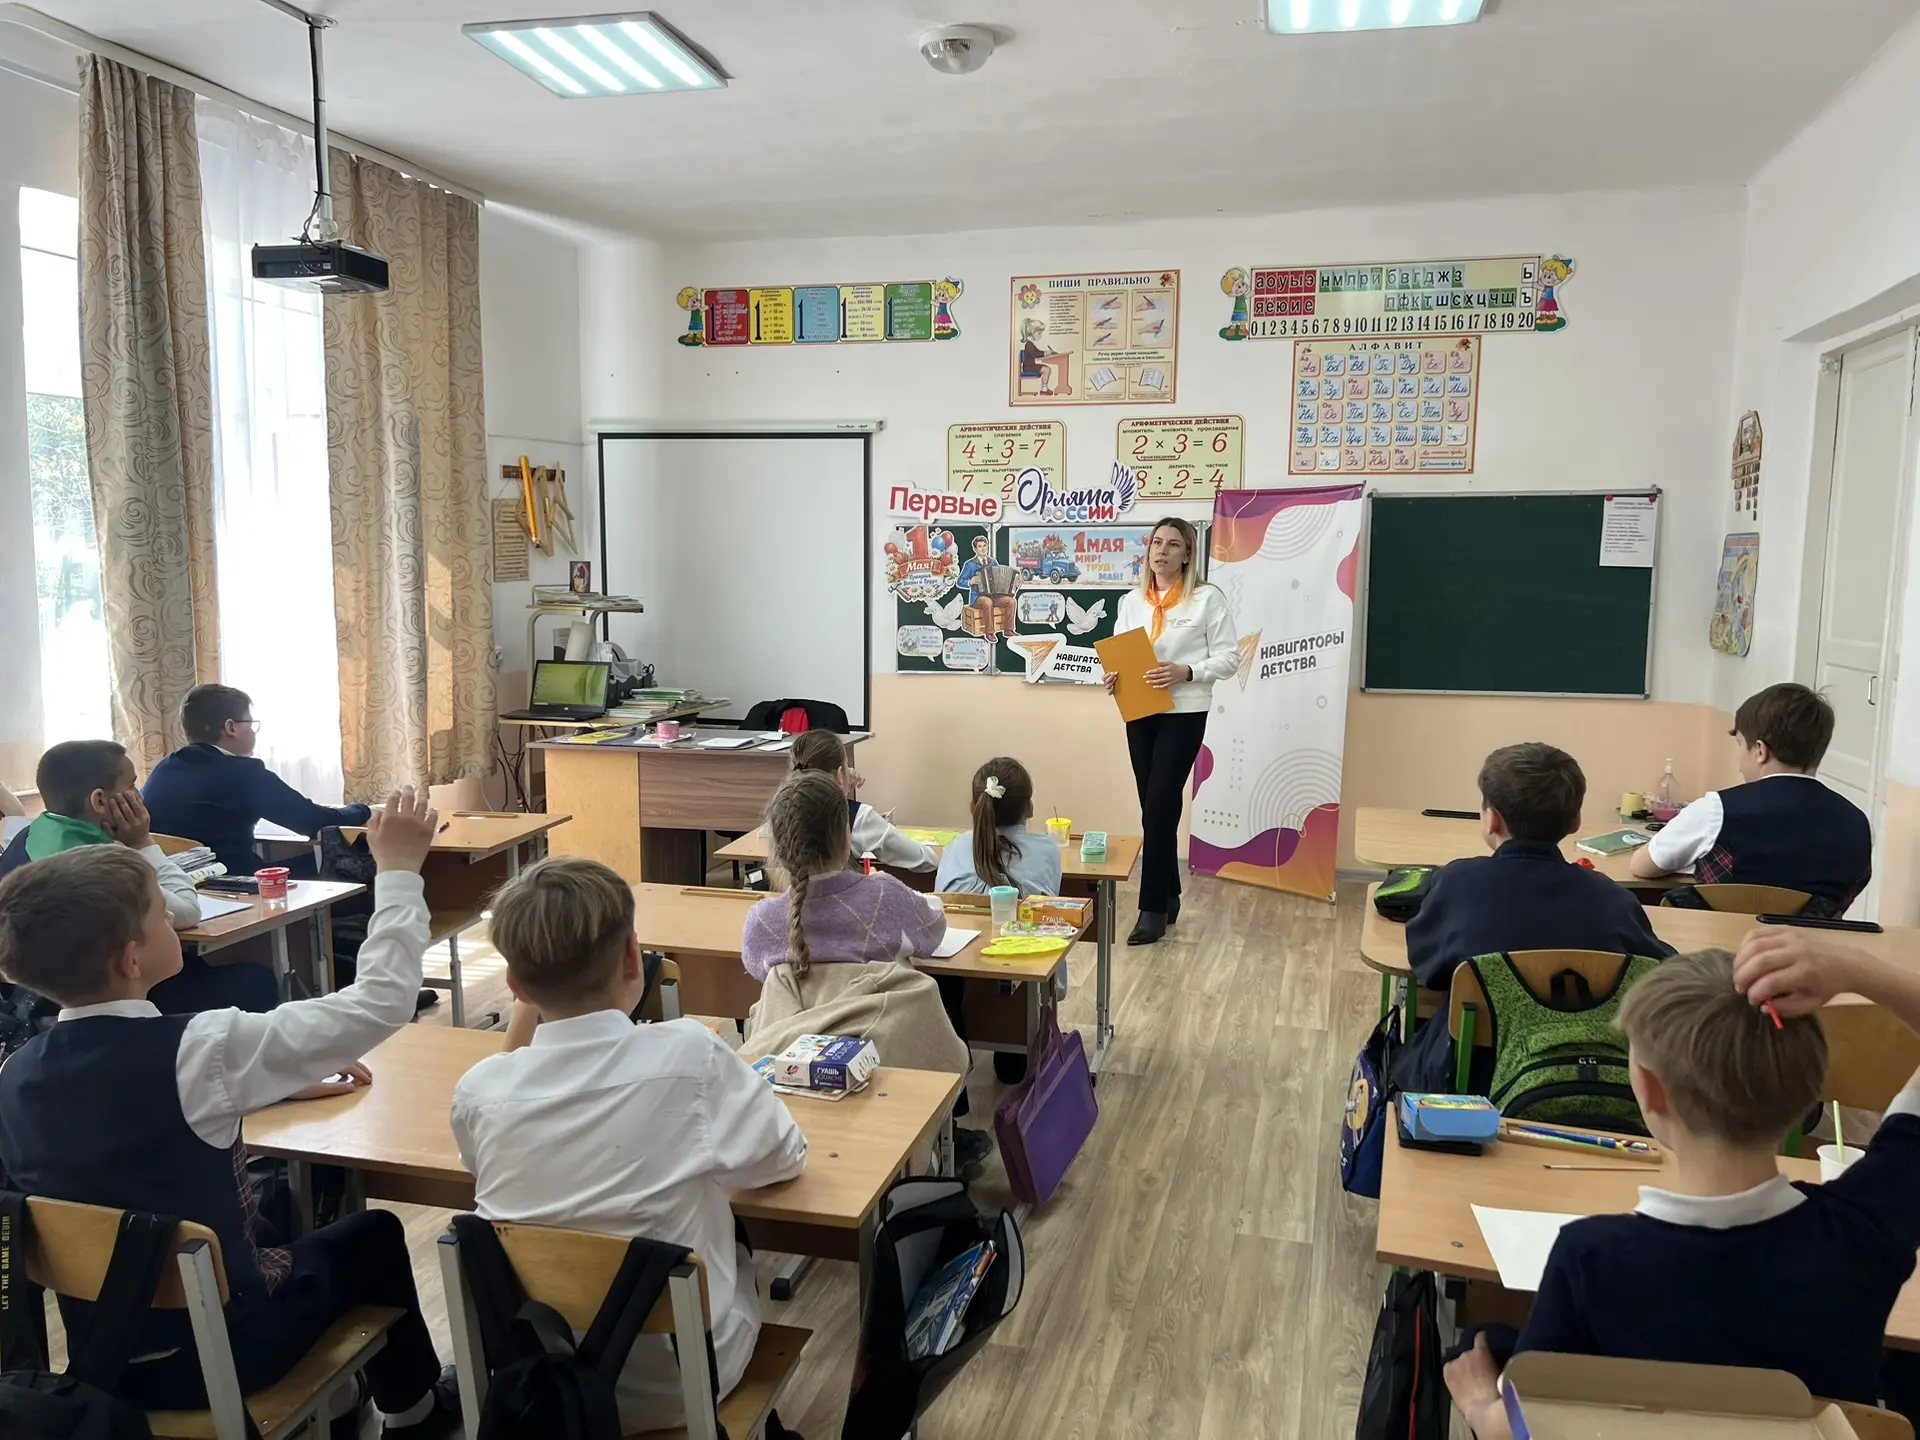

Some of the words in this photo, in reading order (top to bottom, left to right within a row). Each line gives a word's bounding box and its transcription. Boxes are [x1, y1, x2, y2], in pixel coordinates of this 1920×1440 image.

[1048, 280, 1081, 289] ПИШИ
[1087, 276, 1151, 287] ПРАВИЛЬНО
[1251, 321, 1258, 336] 0
[1262, 321, 1266, 336] 1
[1270, 320, 1277, 335] 2
[1280, 320, 1287, 335] 3
[1291, 320, 1298, 335] 4
[1302, 319, 1308, 334] 5
[1312, 319, 1319, 334] 6
[1323, 319, 1329, 334] 7
[1333, 318, 1340, 333] 8
[1344, 318, 1351, 333] 9
[1355, 317, 1367, 332] 10
[1371, 317, 1381, 332] 11
[1385, 316, 1397, 332] 12
[1401, 316, 1414, 331] 13
[1418, 315, 1430, 331] 14
[1434, 315, 1447, 330] 15
[1451, 314, 1464, 330] 16
[1468, 314, 1480, 329] 17
[1484, 313, 1497, 329] 18
[1501, 312, 1514, 328] 19
[1518, 312, 1534, 328] 20
[1348, 341, 1424, 351] АЛФАВИТ
[1131, 419, 1193, 427] АРИФМЕТИЧЕСКИЕ
[962, 440, 976, 459] 4
[1000, 439, 1015, 459] 3
[1033, 439, 1046, 458] 7
[1132, 434, 1149, 455] 2
[1173, 433, 1188, 454] 3
[1212, 432, 1228, 453] 6
[962, 474, 974, 492] 7
[1000, 473, 1016, 492] 2
[1136, 469, 1148, 490] 8
[1173, 469, 1190, 489] 2
[1209, 468, 1224, 489] 4
[1018, 468, 1116, 516] Орлята
[889, 486, 998, 520] Первые
[906, 524, 929, 559] 1
[1072, 531, 1087, 553] 1
[1087, 537, 1125, 553] МАЯ
[906, 561, 934, 573] Мая!
[1075, 554, 1102, 563] МИР!
[1086, 563, 1115, 572] ТРУД!
[1098, 572, 1124, 581] МАЙ!
[1260, 631, 1345, 660] НАВИГАТОРЫ
[1055, 652, 1102, 665] НАВИГАТО
[1260, 655, 1317, 679] ДЕТСТВА
[1053, 662, 1092, 674] ДЕТСТВА
[816, 1067, 840, 1076] ГУАШЬ
[1, 1246, 10, 1270] GAME
[1, 1273, 9, 1290] THE
[1, 1294, 9, 1310] LET
